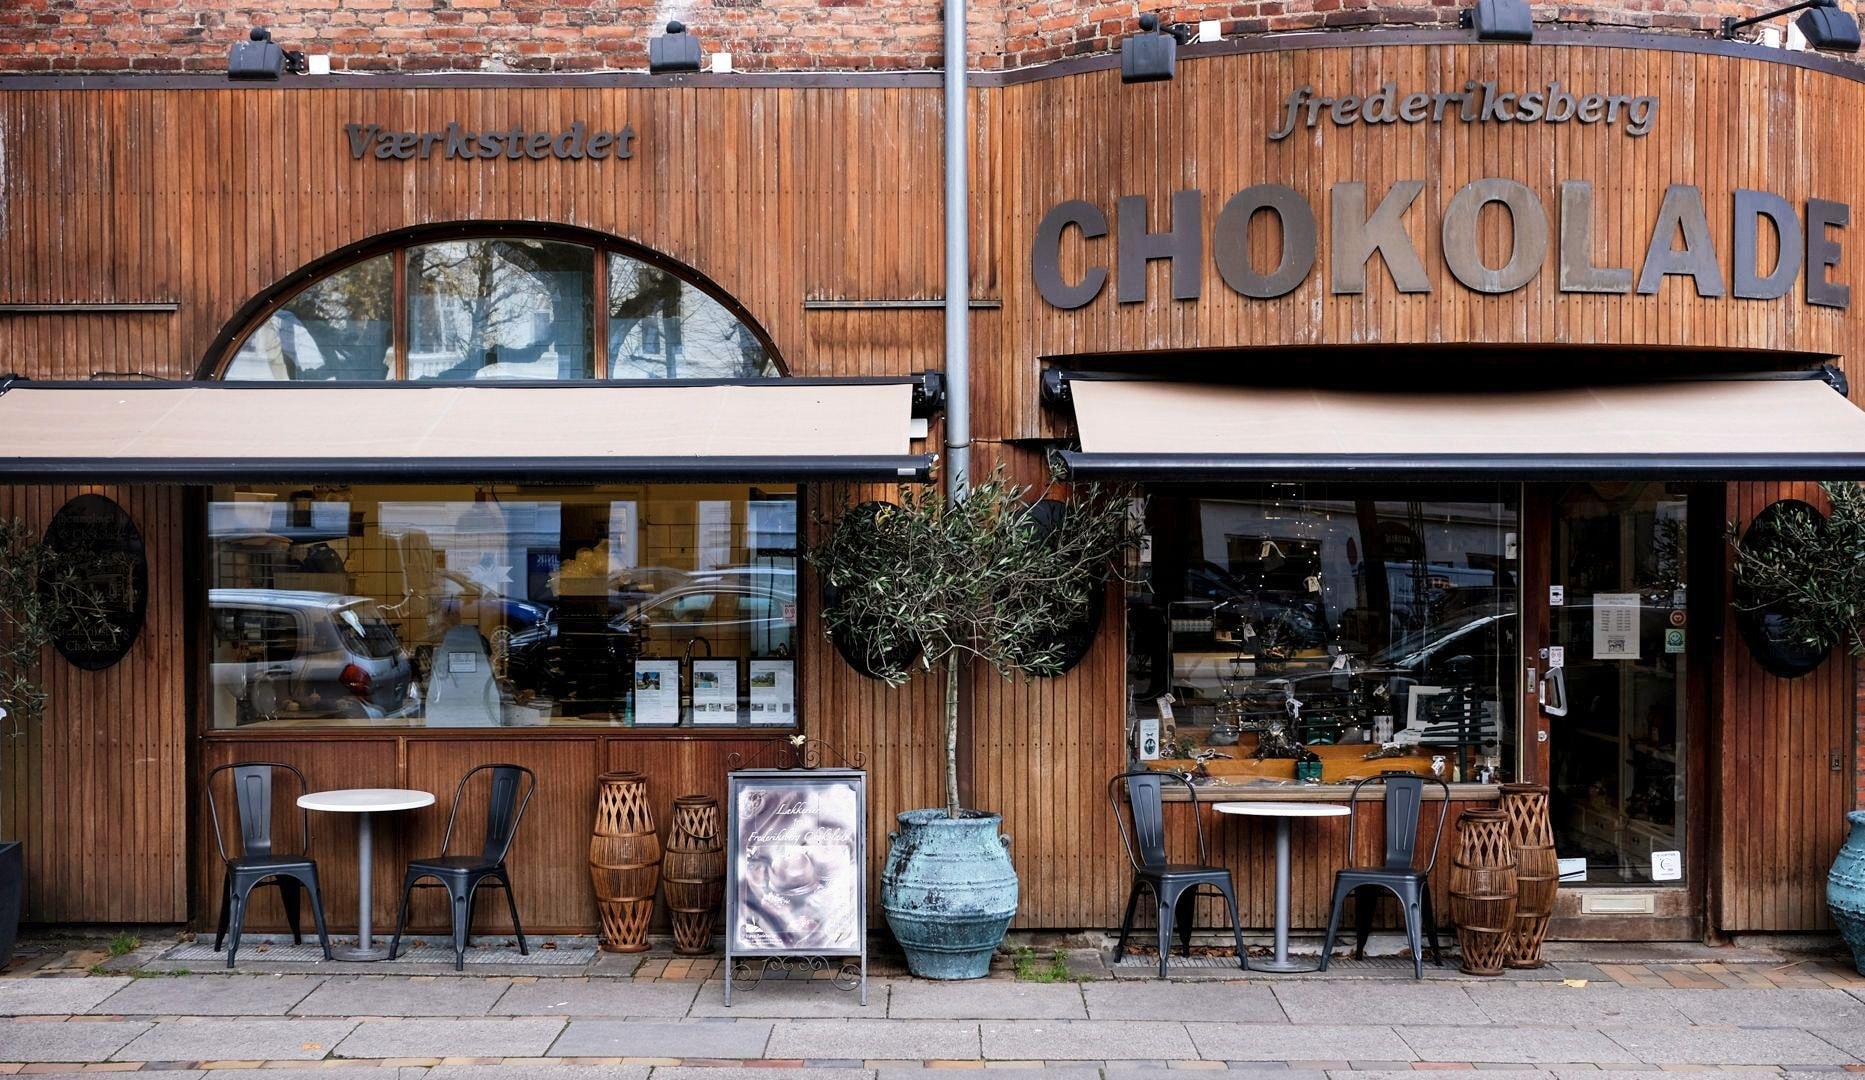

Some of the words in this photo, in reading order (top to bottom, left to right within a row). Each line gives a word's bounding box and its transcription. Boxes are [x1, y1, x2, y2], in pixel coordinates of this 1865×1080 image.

[1268, 79, 1659, 140] frederiksberg
[344, 121, 636, 160] Værkstedet
[1033, 178, 1850, 309] CHOKOLADE
